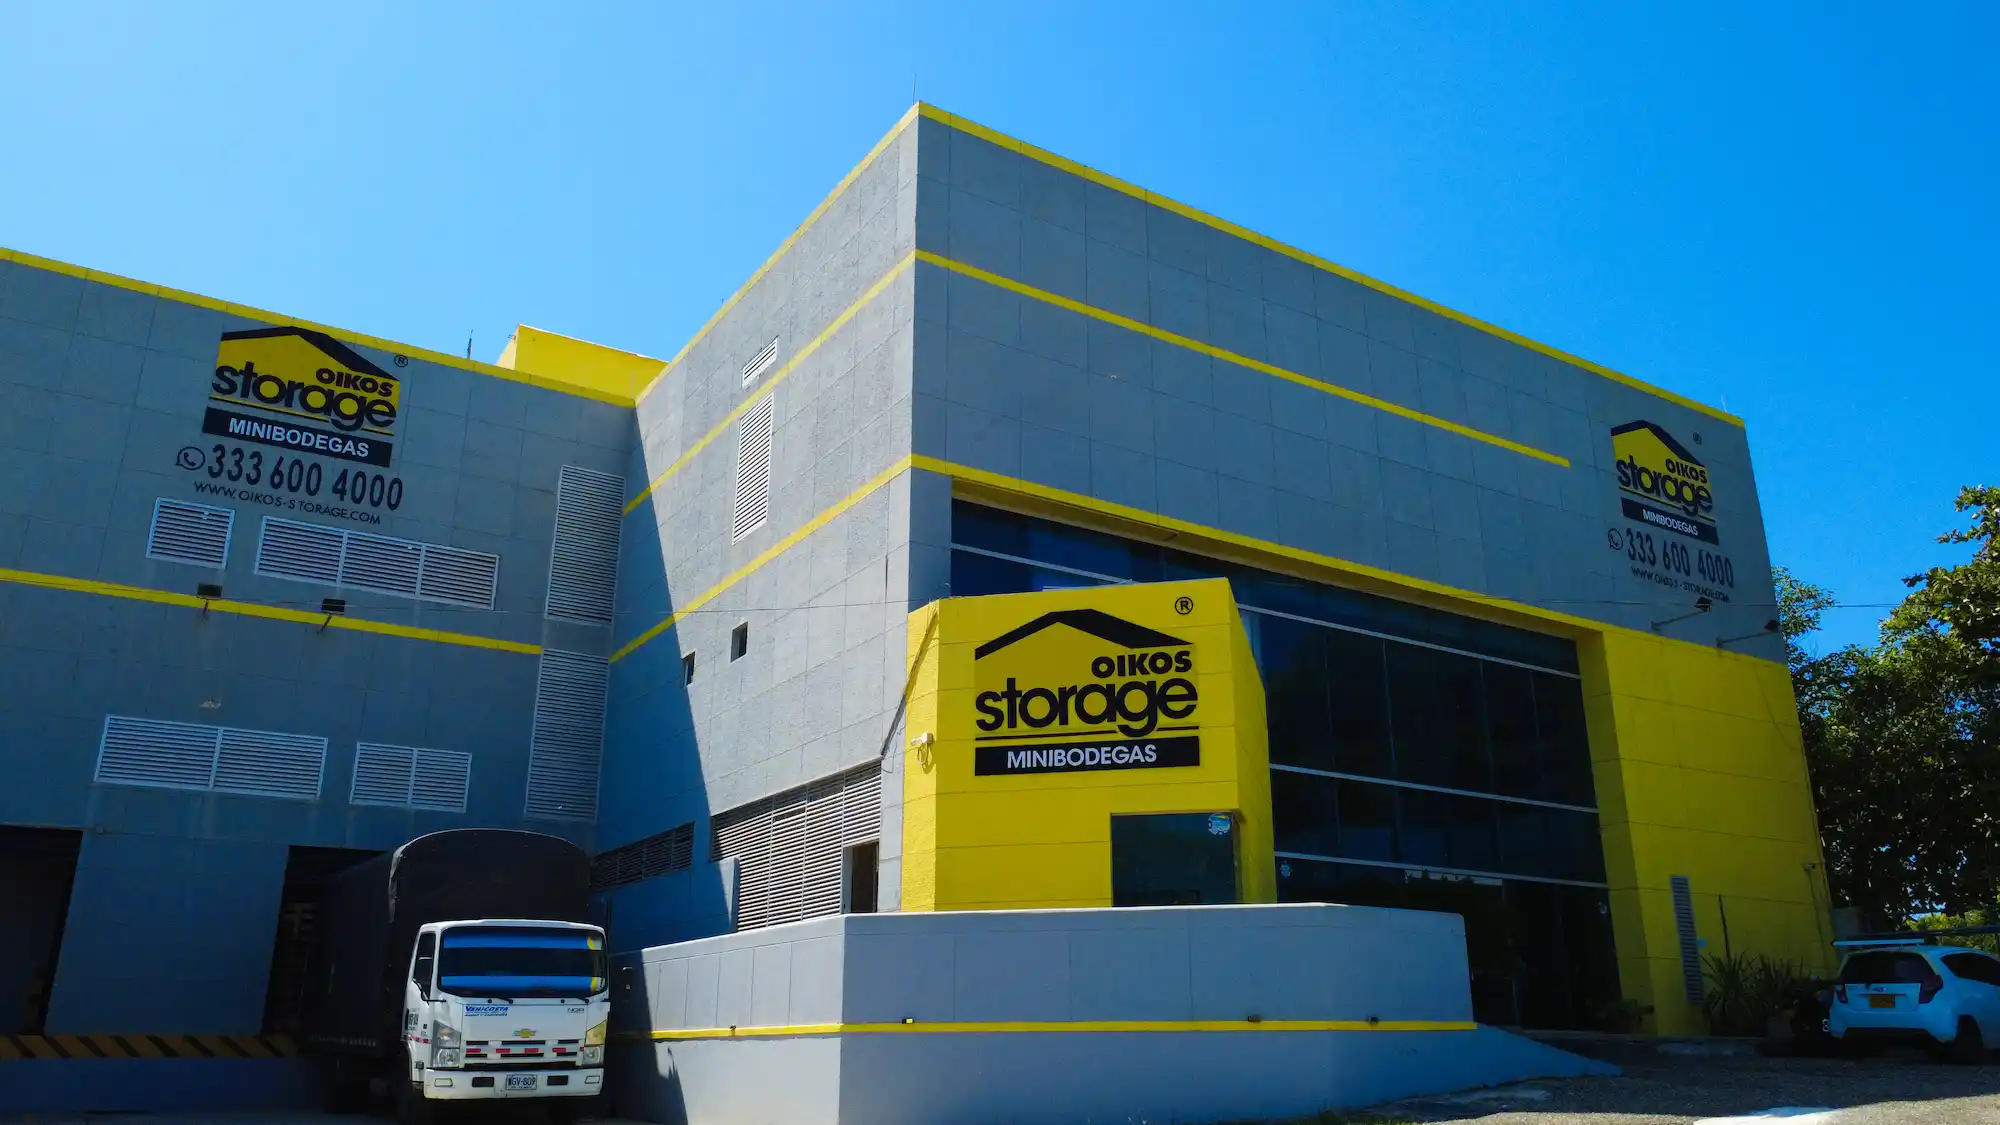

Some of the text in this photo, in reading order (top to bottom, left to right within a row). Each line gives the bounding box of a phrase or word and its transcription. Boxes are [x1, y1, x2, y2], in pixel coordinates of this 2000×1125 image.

[211, 361, 397, 432] storage
[316, 367, 393, 397] OIKOS
[228, 417, 369, 458] MINIBODEGAS
[208, 444, 403, 511] 333 600 4000
[1615, 454, 1713, 517] storage
[1665, 458, 1708, 484] OIKOS
[1642, 508, 1699, 536] MINIBODEGAS
[1626, 528, 1734, 589] 333 600 4000
[1091, 650, 1193, 678] OIKOS
[975, 677, 1199, 738] storage
[1006, 744, 1157, 769] MINIBODEGAS
